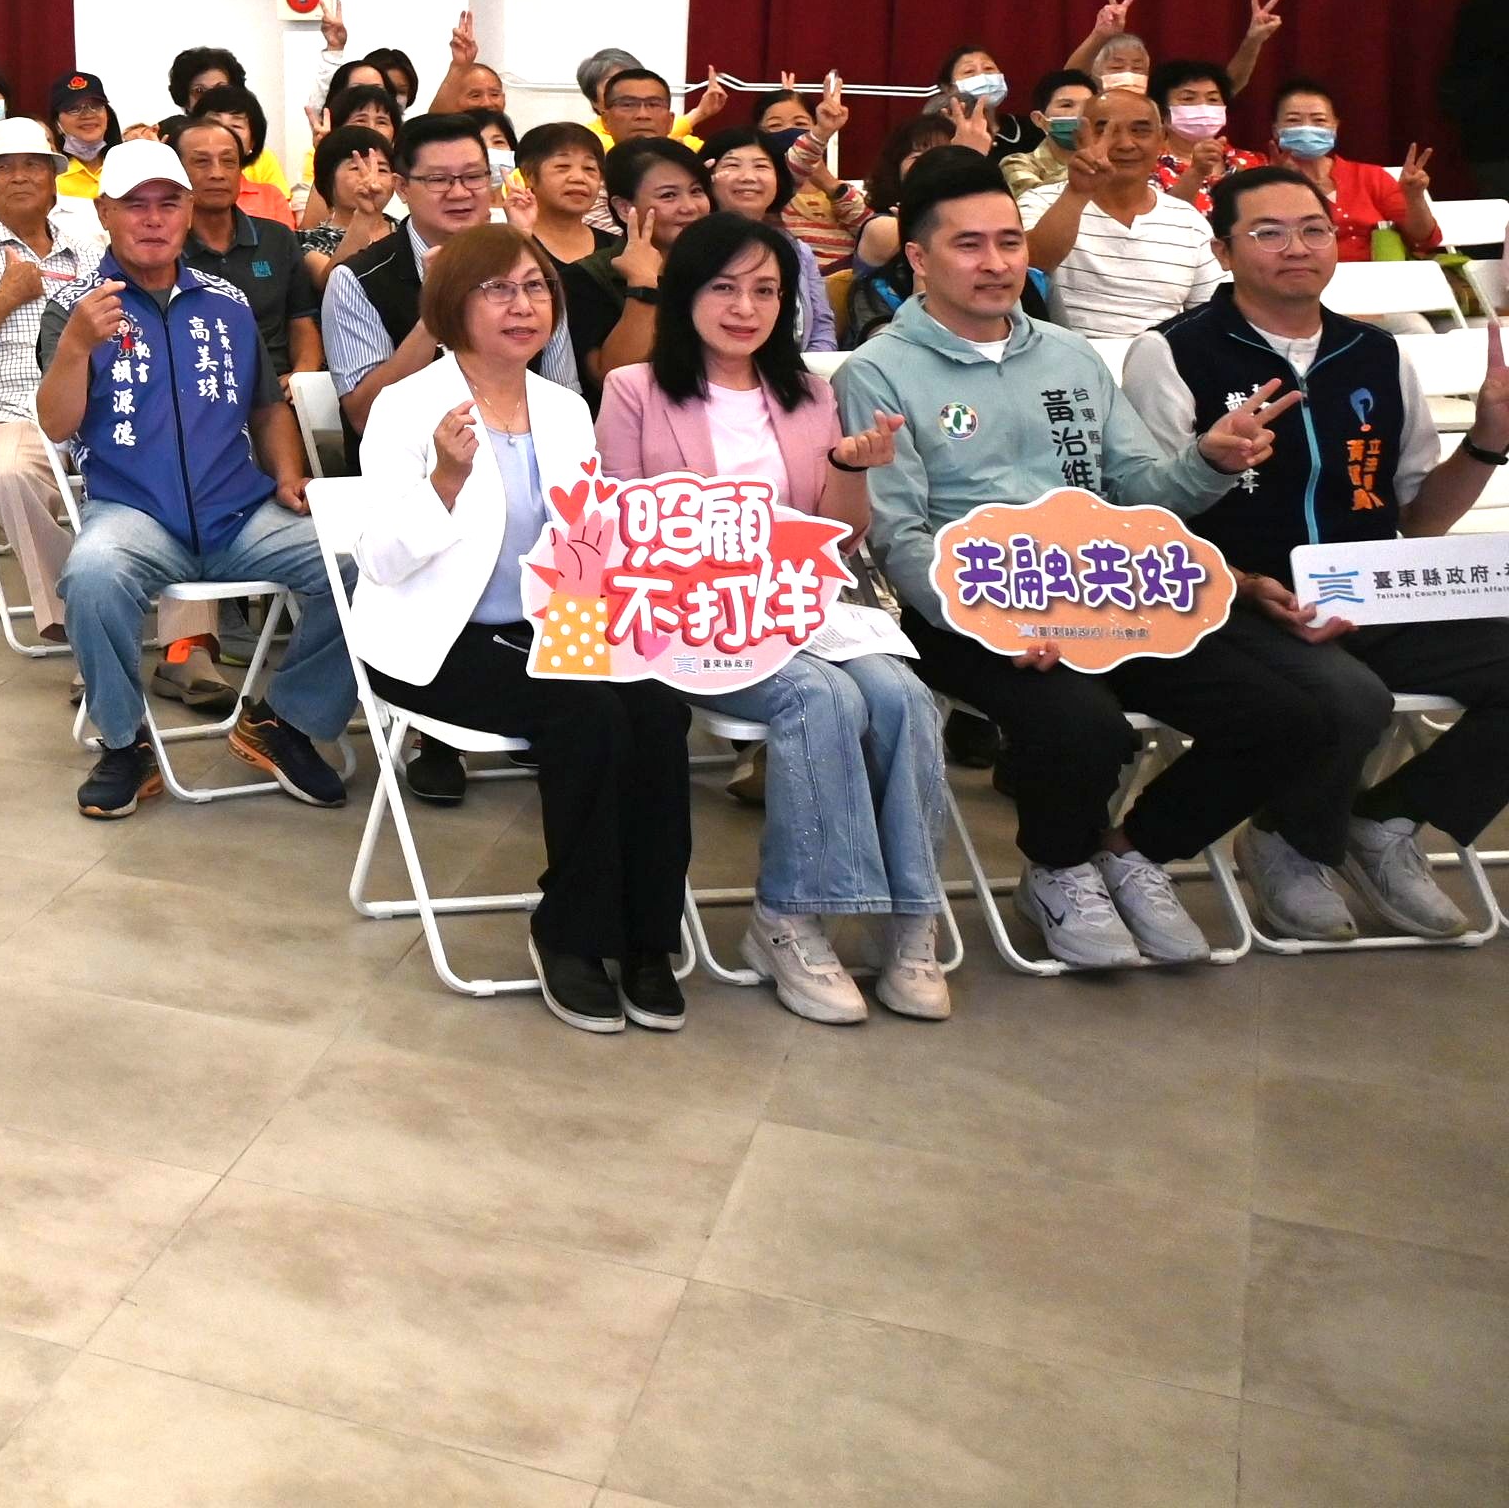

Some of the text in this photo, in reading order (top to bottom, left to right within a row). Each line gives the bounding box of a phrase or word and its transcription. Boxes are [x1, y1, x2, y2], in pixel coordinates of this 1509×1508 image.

[189, 316, 220, 402] 高美珠
[623, 481, 772, 568] 照顧
[611, 558, 821, 648] 不打烊
[956, 537, 1203, 608] 共融共好
